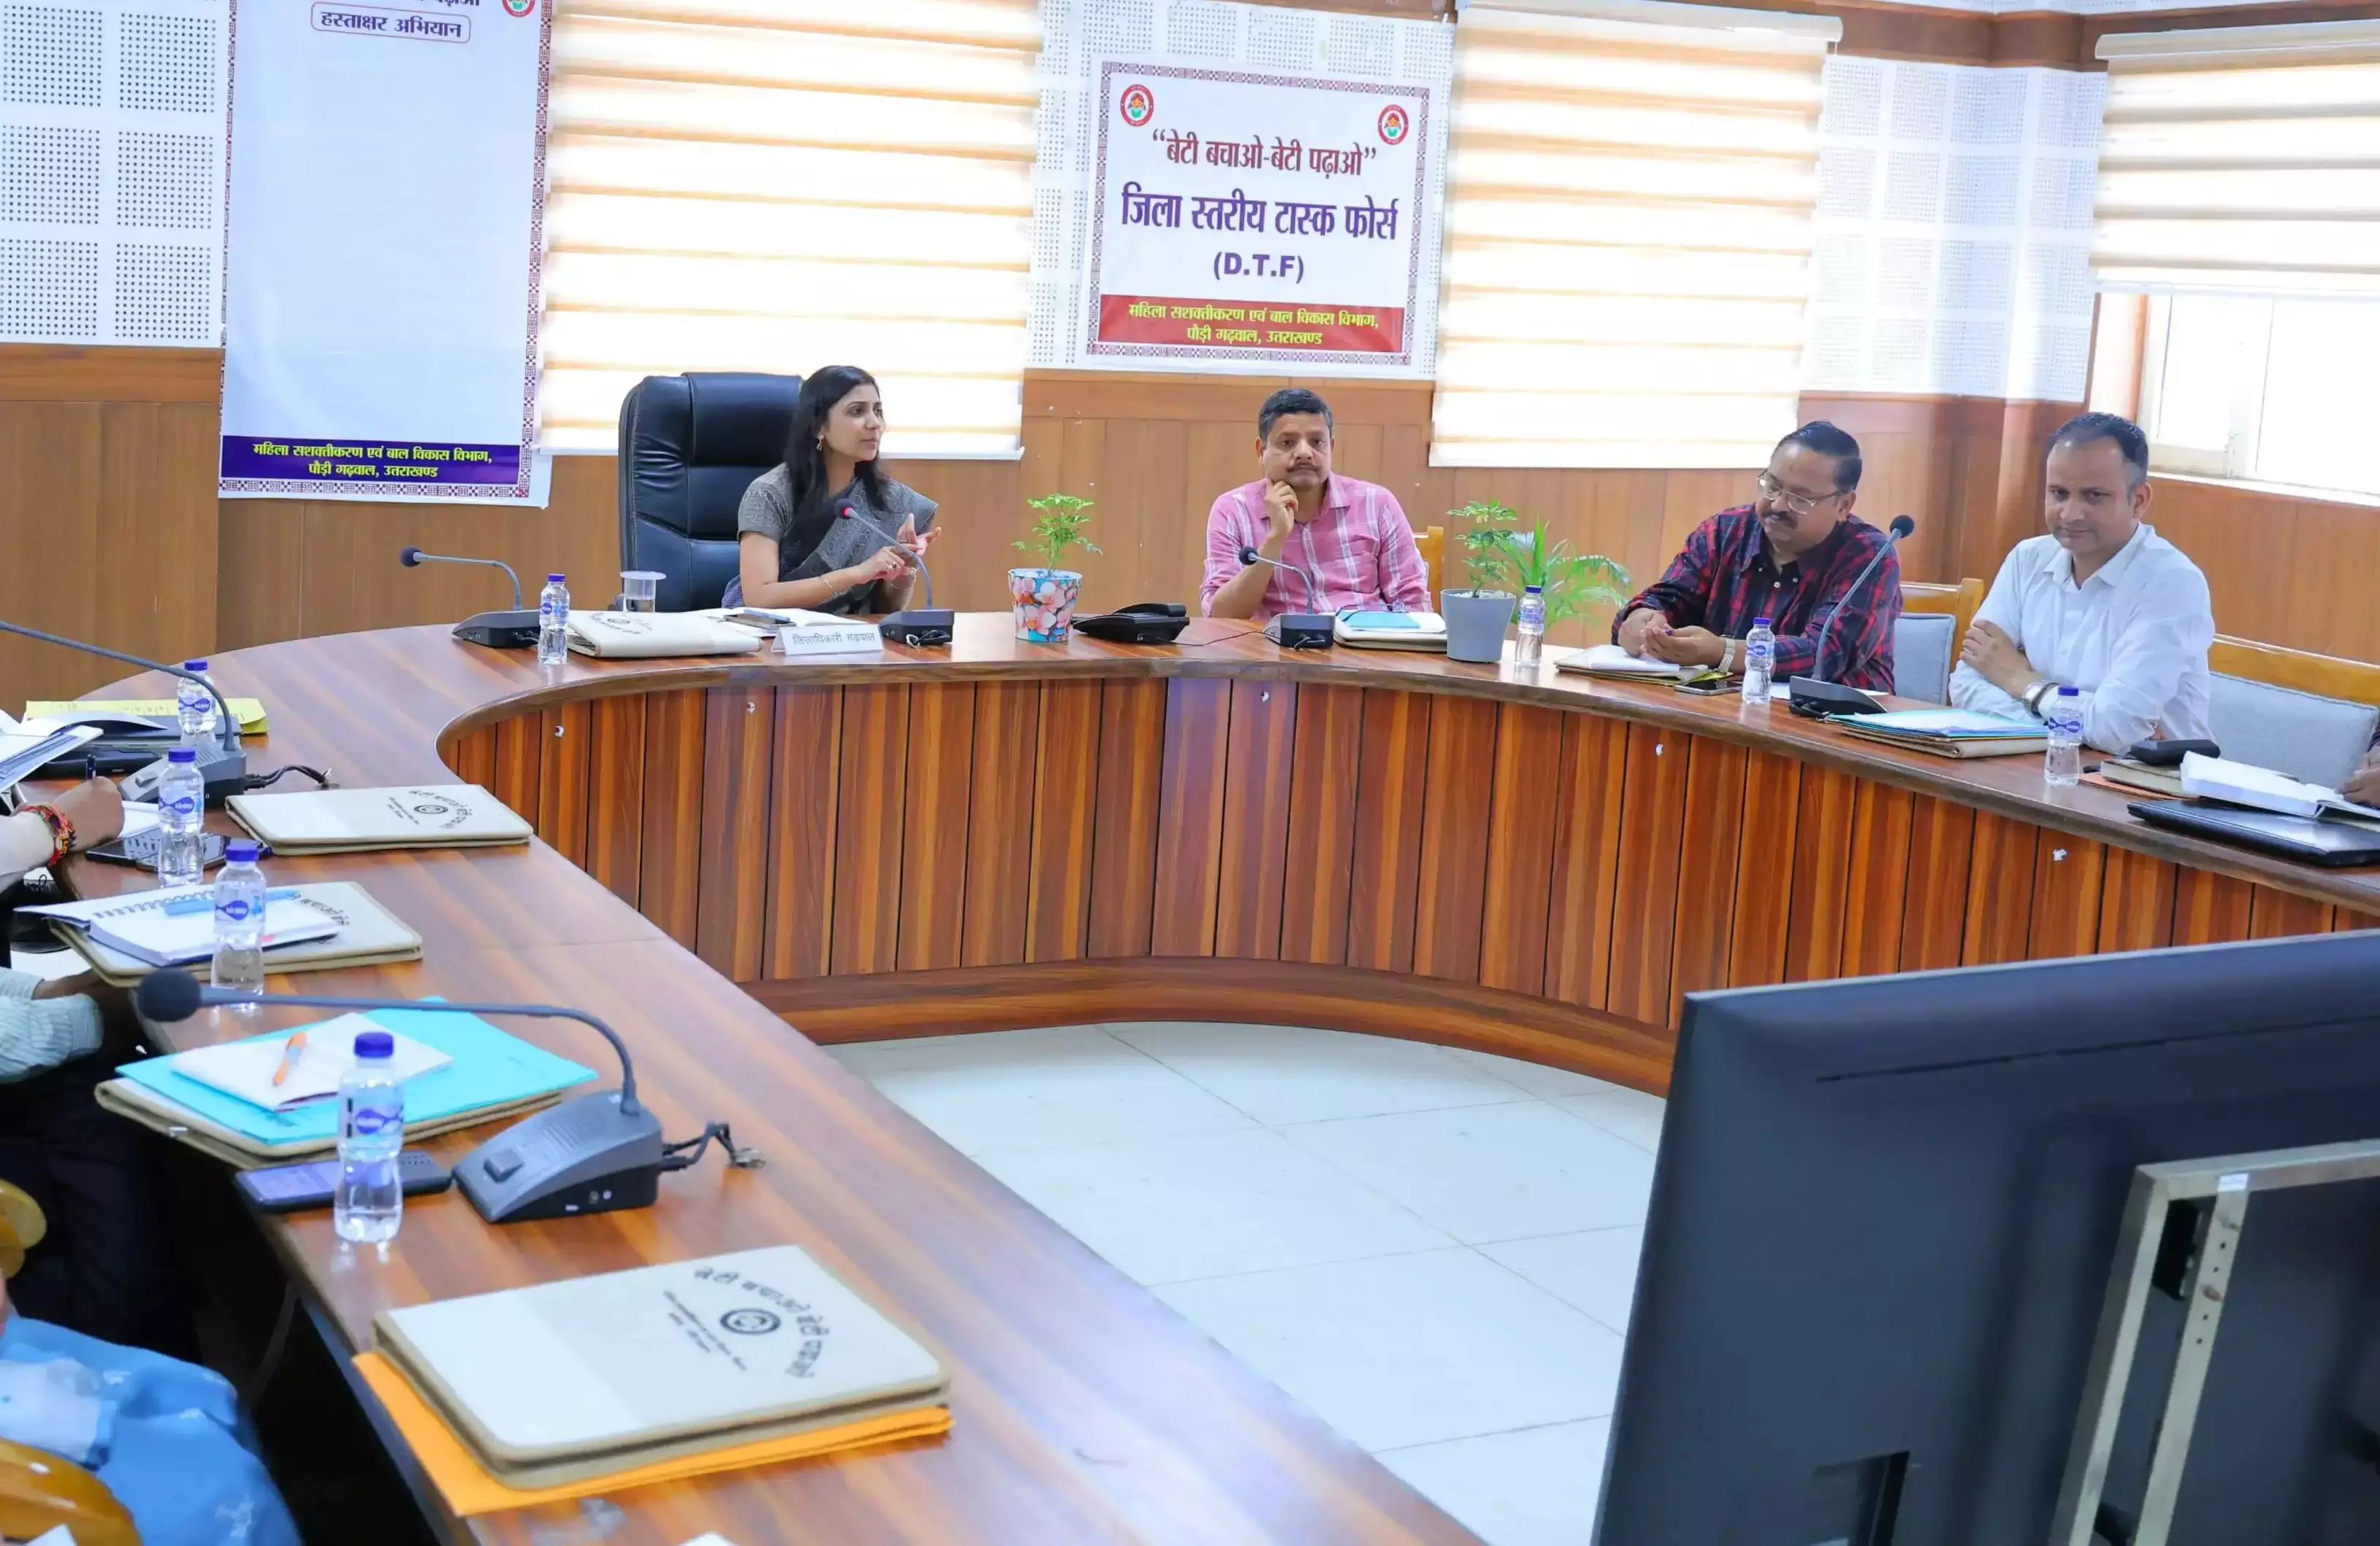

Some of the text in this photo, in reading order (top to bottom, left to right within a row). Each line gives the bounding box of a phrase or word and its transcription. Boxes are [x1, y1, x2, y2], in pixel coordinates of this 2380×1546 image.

[321, 12, 462, 37] हस्ताक्षर अभियान
[1122, 181, 1399, 240] जिला स्तरीय टास्क फोर्स
[1214, 251, 1304, 284] (D.T.F)
[1129, 302, 1166, 319] महिला
[1249, 308, 1266, 322] एवं
[1270, 309, 1293, 324] बाल
[1297, 309, 1334, 325] विकास
[1338, 310, 1378, 327] विभाग,
[1187, 324, 1211, 341] पौड़ी
[1267, 329, 1323, 345] उत्तराखण्ड
[253, 441, 289, 455] महिला
[367, 446, 384, 458] एवं
[386, 448, 409, 458] बाल
[412, 446, 450, 461] विकास
[453, 448, 492, 464] विभाग,
[309, 460, 332, 476] पौड़ी
[384, 466, 439, 477] उत्तराखण्ड
